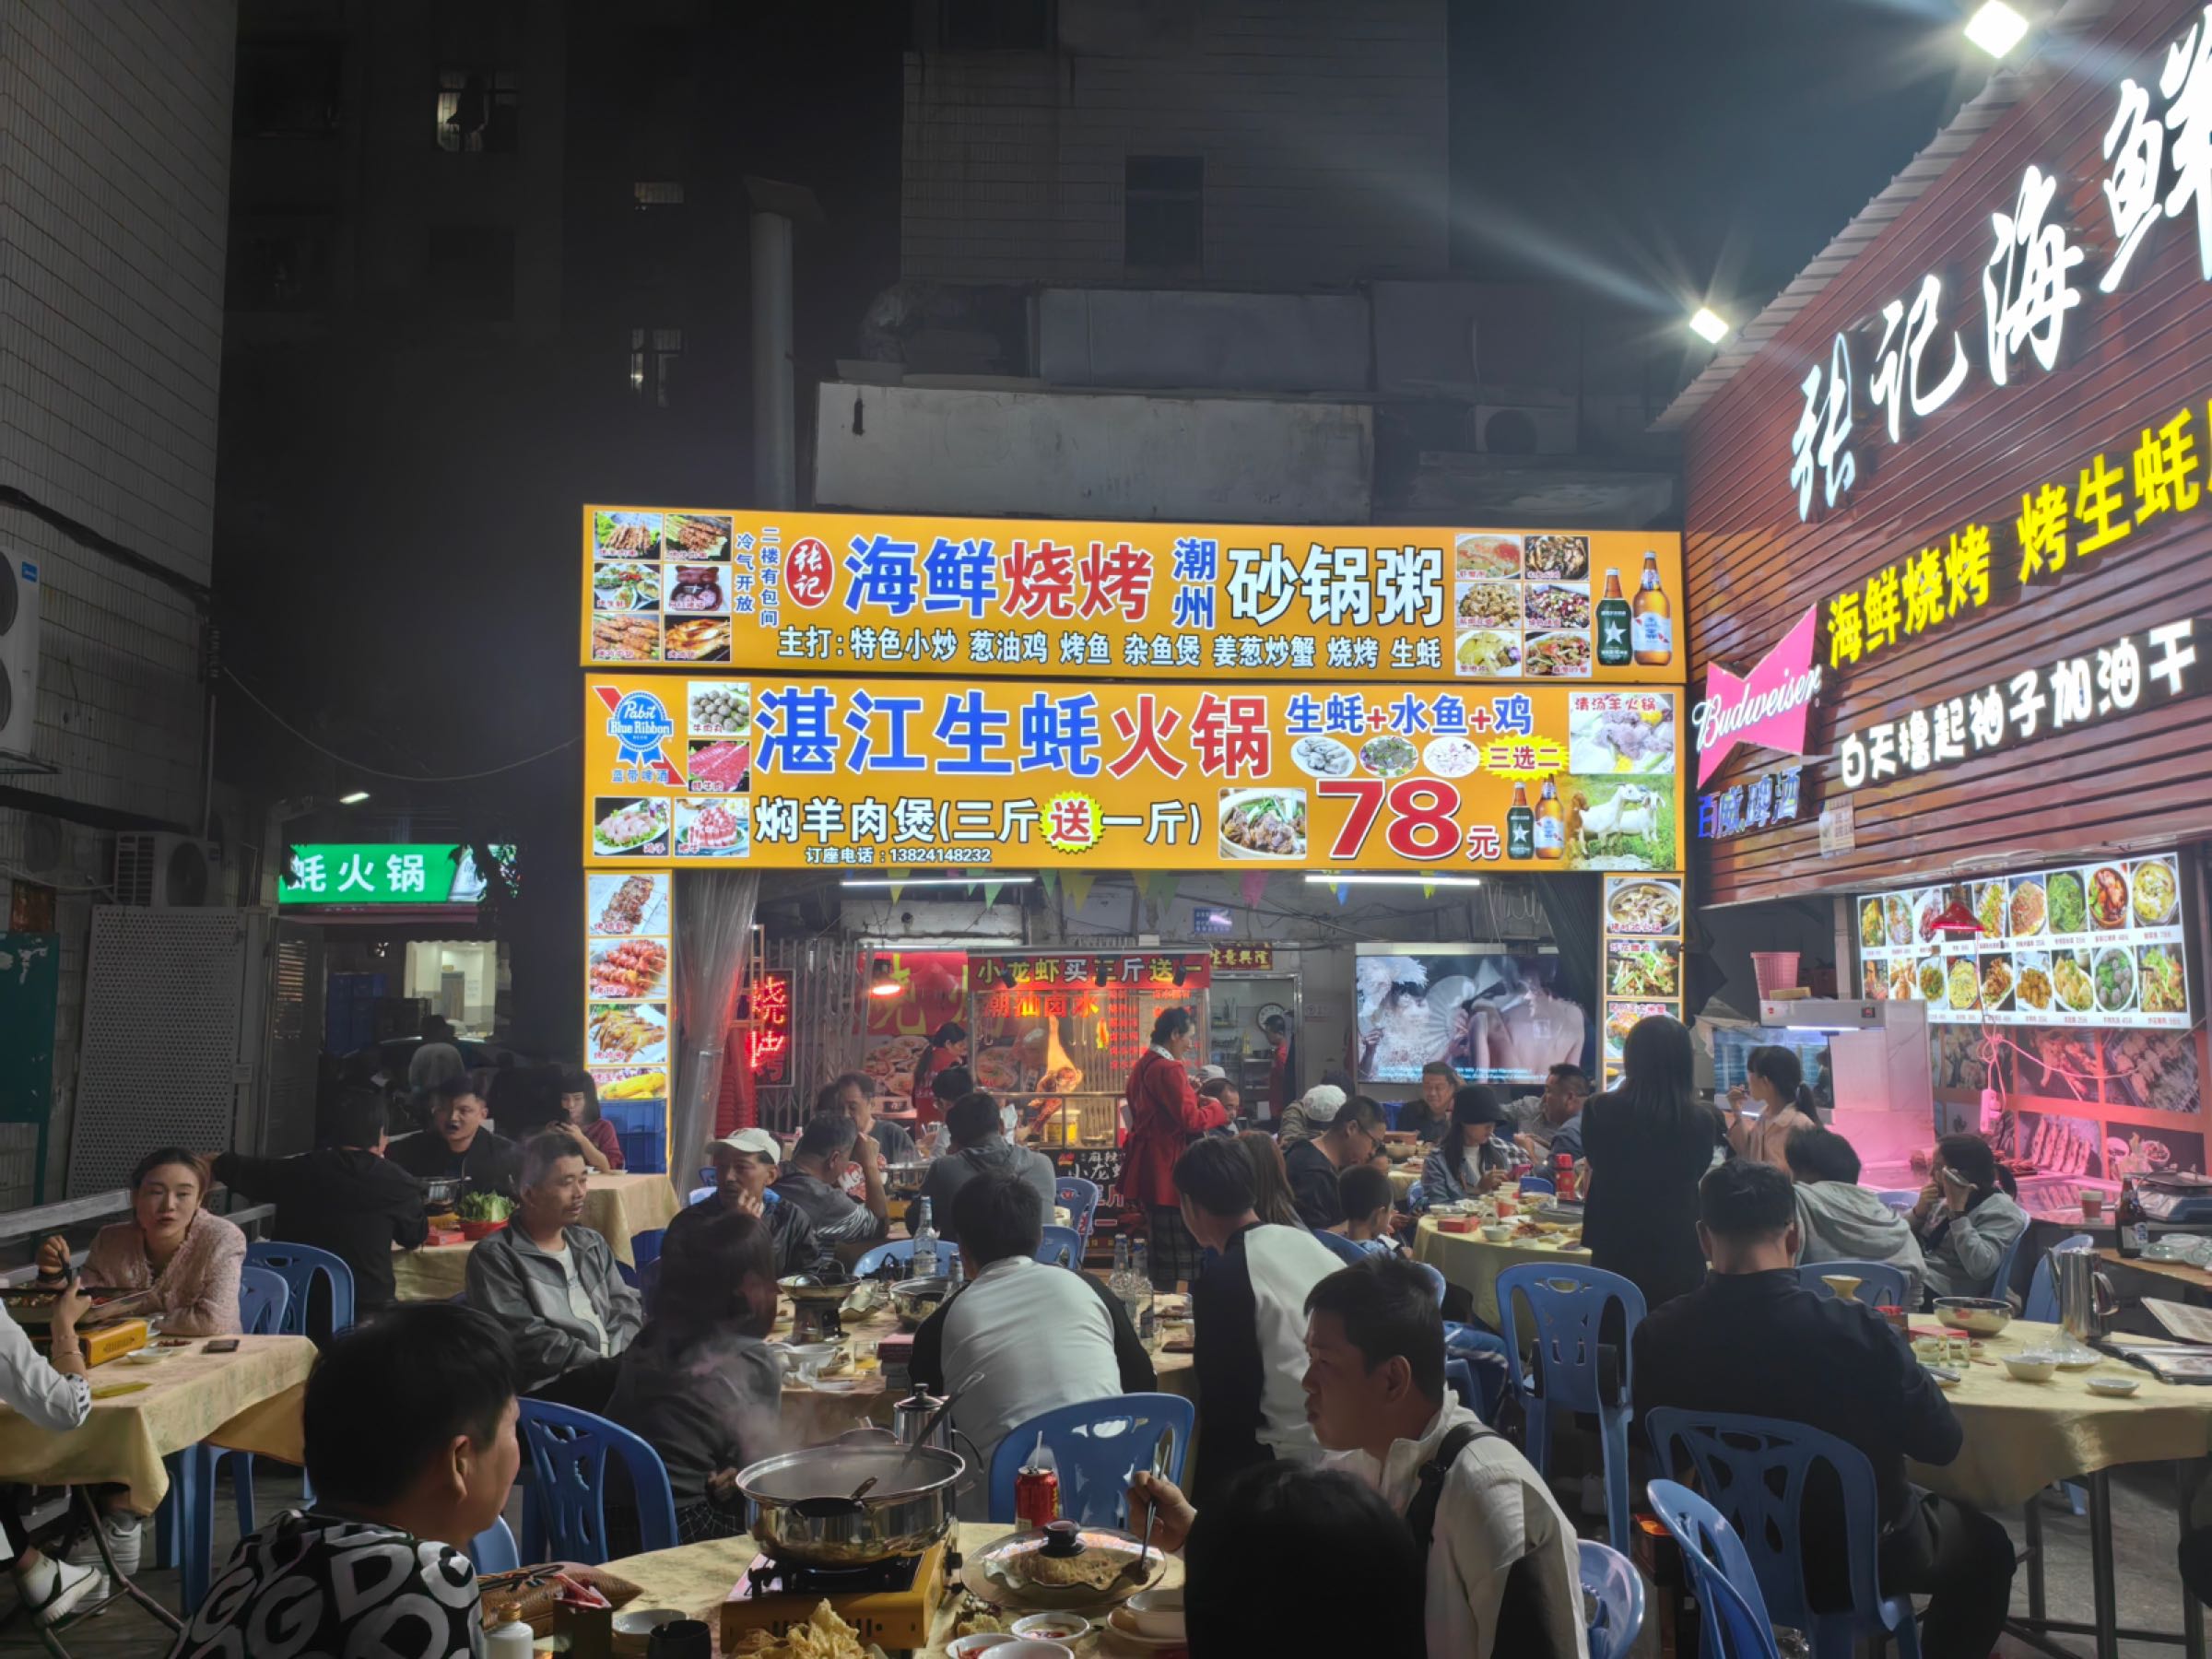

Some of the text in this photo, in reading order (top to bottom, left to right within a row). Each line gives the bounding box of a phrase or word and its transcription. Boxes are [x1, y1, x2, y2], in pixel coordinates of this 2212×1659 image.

[1828, 398, 2212, 670] 海鲜烧烤 烤生蚝
[735, 533, 755, 613] 冷气开放
[760, 527, 779, 627] 二楼有包间
[794, 542, 825, 598] 张记
[844, 534, 1443, 630] 海鲜烧烤 潮州 砂锅粥
[969, 629, 1047, 665] 葱油鸡
[1059, 631, 1112, 666] 烤鱼
[1124, 632, 1202, 668] 杂鱼煲
[1213, 634, 1315, 669] 姜葱炒蟹
[1327, 636, 1380, 670] 烧烤
[1390, 637, 1441, 671] 生蚝
[610, 721, 670, 734] Blue Ribbon
[623, 700, 656, 719] Pabst
[1285, 692, 1534, 735] 生蚝+水鱼+鸡
[1575, 697, 1656, 711] 清汤羊火锅
[1692, 664, 1821, 753] Budweiser
[754, 686, 1272, 781] 湛江生蚝火锅
[1488, 746, 1561, 771] 三选二
